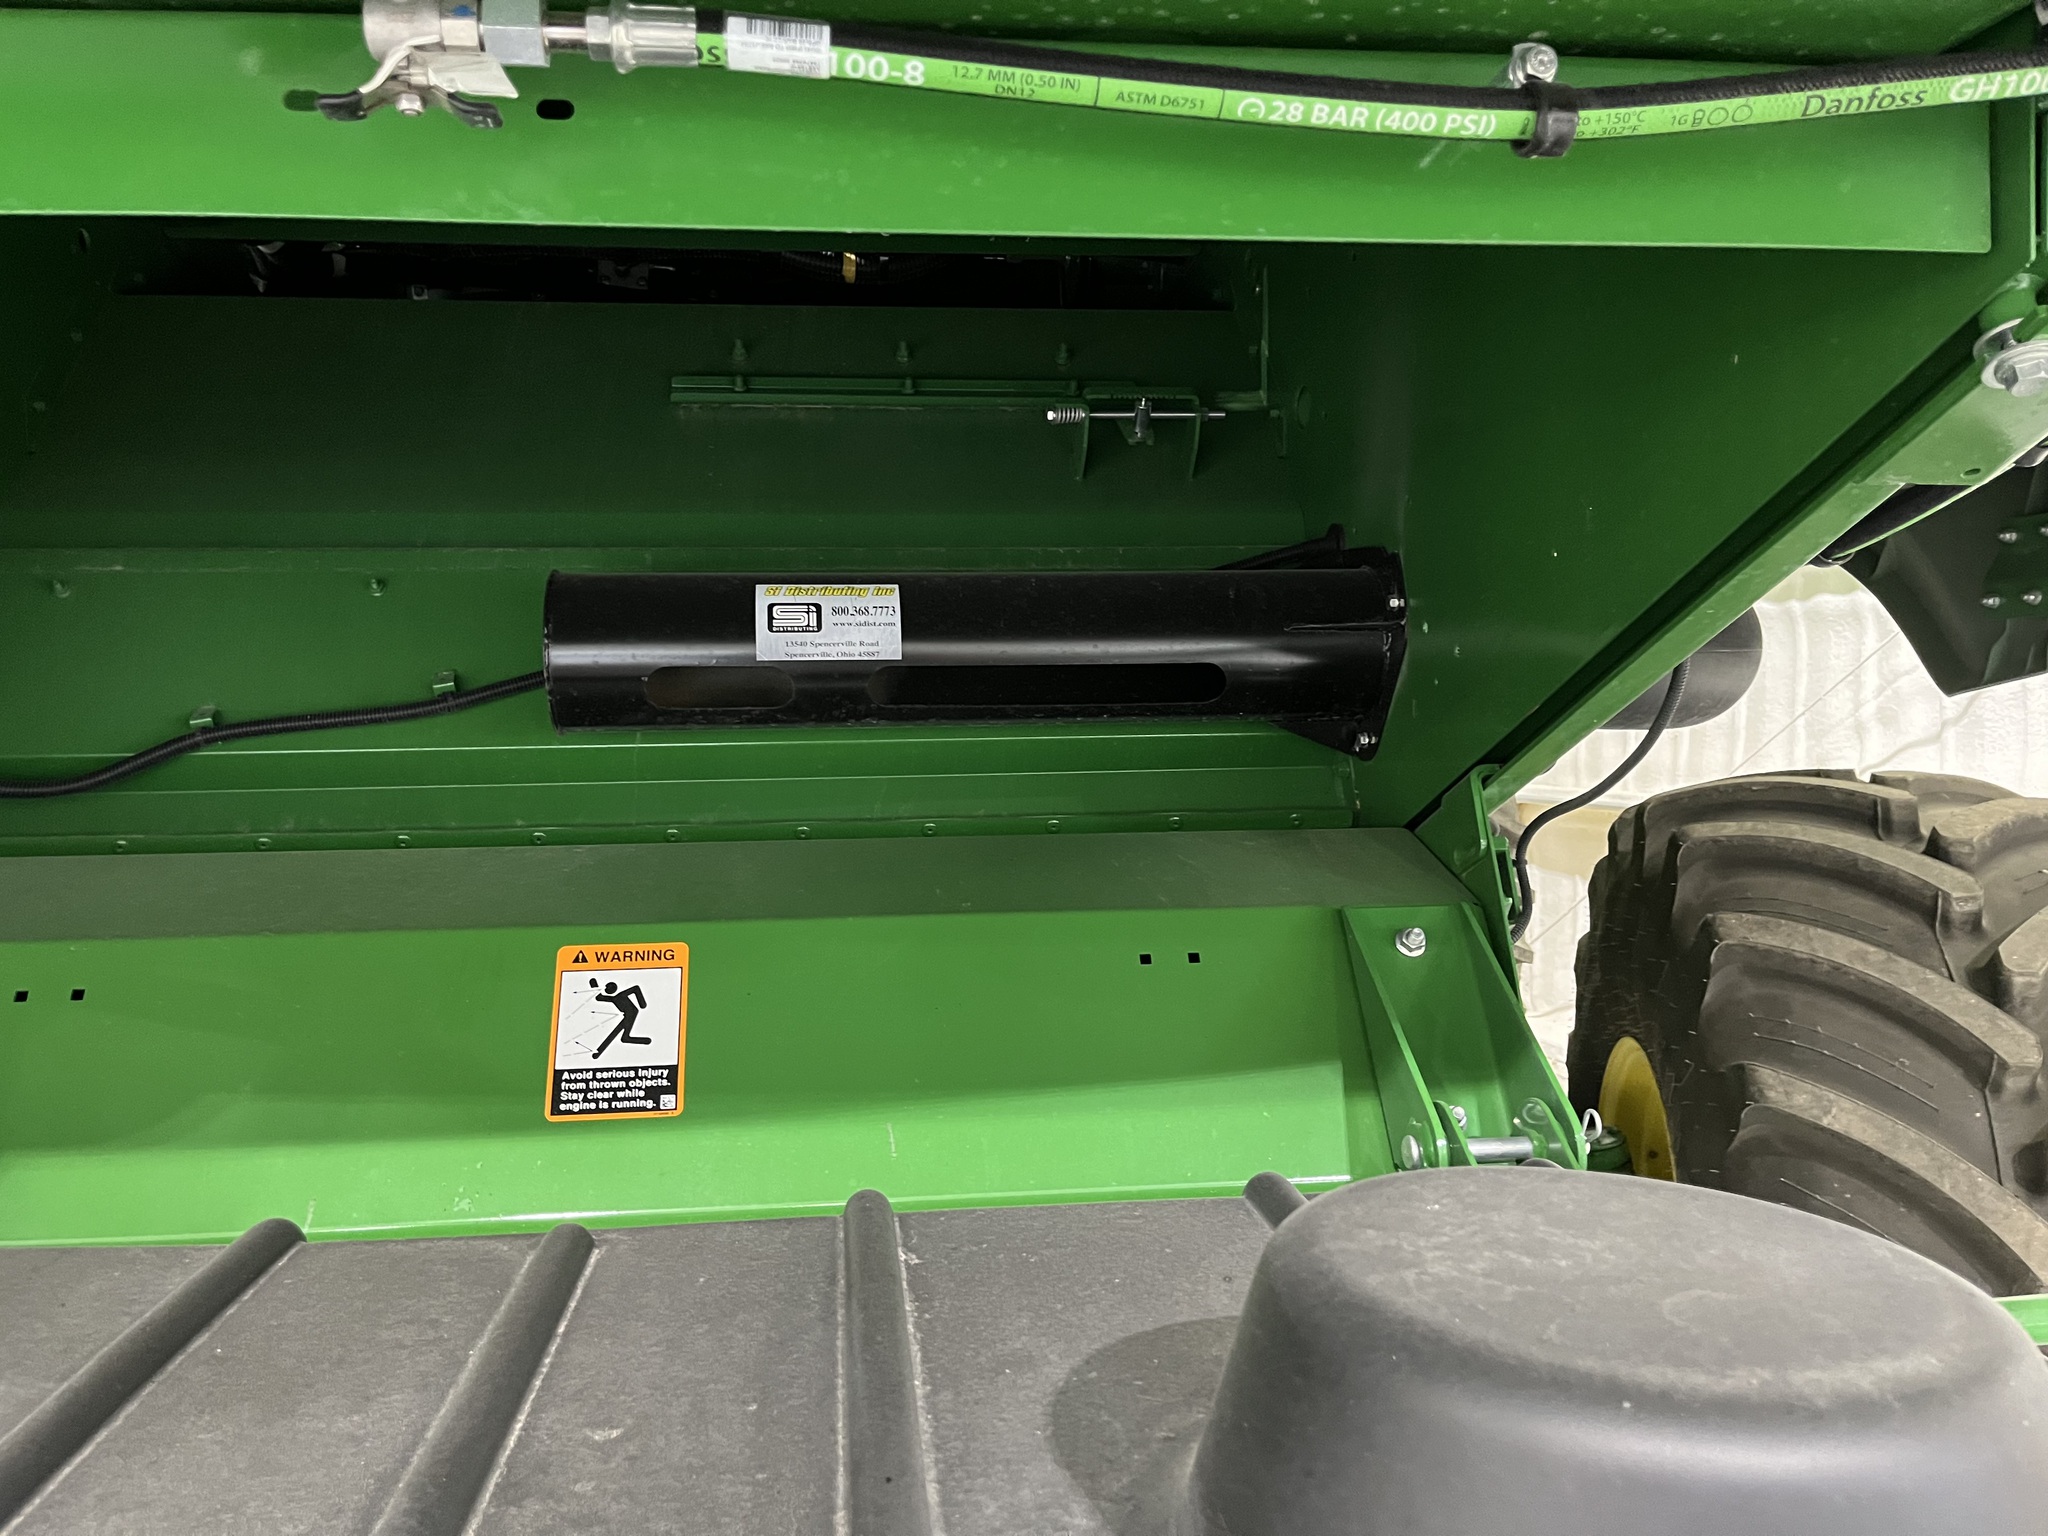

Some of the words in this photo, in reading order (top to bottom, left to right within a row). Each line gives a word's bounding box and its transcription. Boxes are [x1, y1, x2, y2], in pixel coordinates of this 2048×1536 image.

[952, 65, 982, 80] 12.7
[987, 68, 1015, 85] MM
[1020, 72, 1056, 89] (0.50
[1060, 78, 1081, 92] IN)
[1115, 91, 1157, 106] ASTM
[1160, 93, 1205, 110] D6751
[1801, 86, 1929, 118] Danfoss
[1268, 100, 1304, 122] 28
[1310, 104, 1370, 129] BAR
[1376, 108, 1437, 133] (400
[1443, 112, 1496, 137] PSI)
[784, 586, 870, 598] Distributing
[831, 606, 896, 616] 800.368.7773
[809, 641, 857, 649] Spencerville
[858, 640, 880, 648] Road
[594, 949, 675, 963] WARNING
[561, 1071, 593, 1080] Avoid
[595, 1069, 636, 1080] serious
[560, 1081, 587, 1091] from
[588, 1079, 627, 1090] thrown
[628, 1078, 671, 1089] objects.
[559, 1091, 585, 1102] Stay
[586, 1091, 614, 1100] clear
[616, 1089, 645, 1098] while
[559, 1101, 596, 1112] engine
[598, 1100, 609, 1109] is
[611, 1099, 657, 1109] running.
